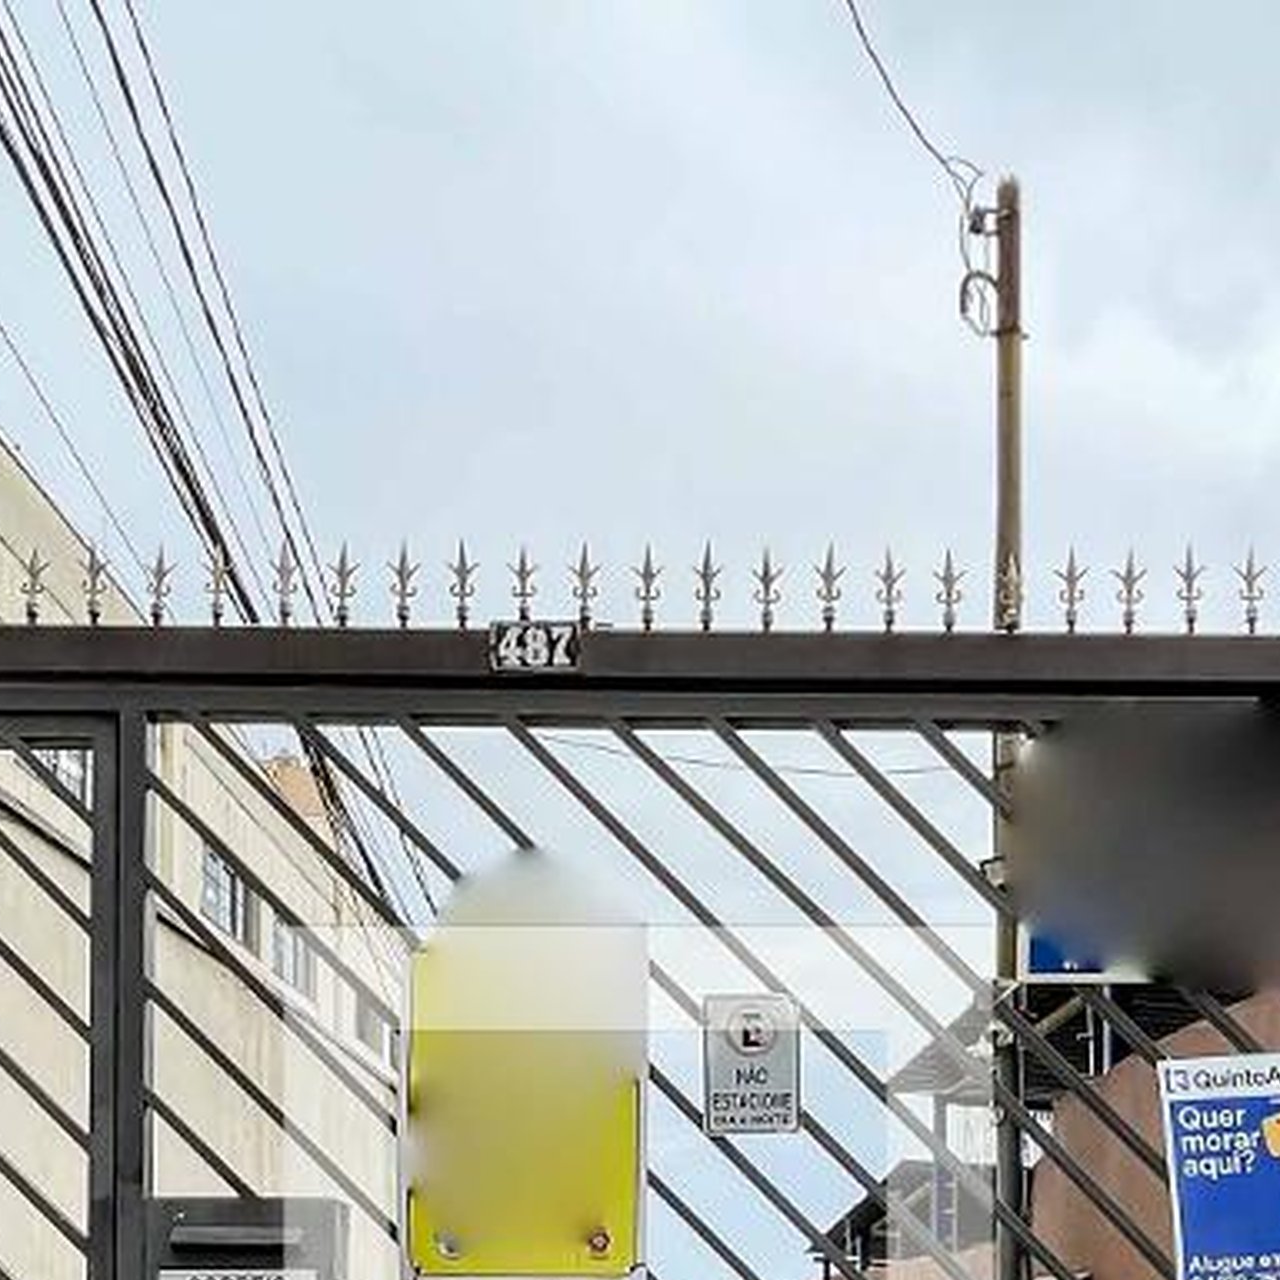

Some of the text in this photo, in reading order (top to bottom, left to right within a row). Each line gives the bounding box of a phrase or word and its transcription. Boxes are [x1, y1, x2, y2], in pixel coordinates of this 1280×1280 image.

[498, 624, 574, 667] 487
[712, 1091, 793, 1111] ESTACIONE
[1177, 1106, 1246, 1132] Quer
[1181, 1130, 1261, 1154] morar
[1183, 1149, 1256, 1181] aqui?
